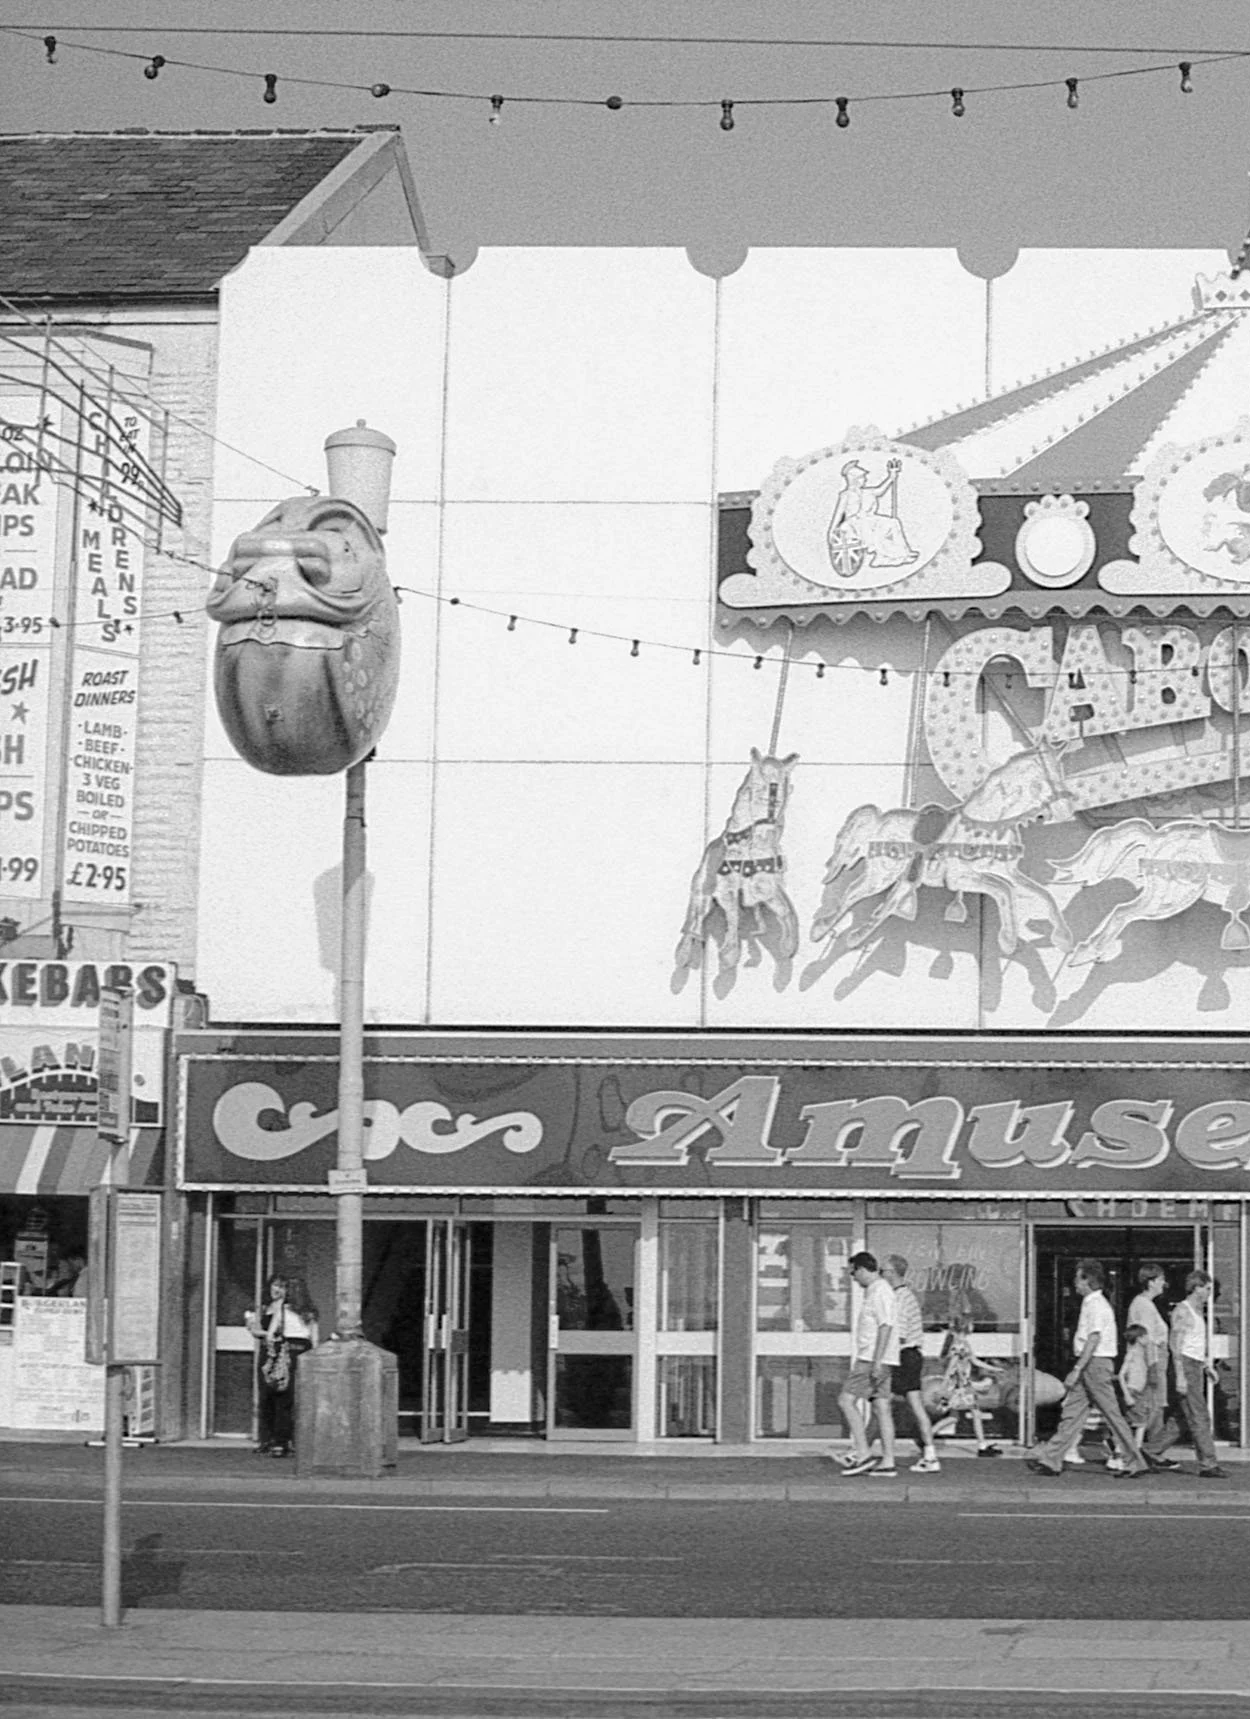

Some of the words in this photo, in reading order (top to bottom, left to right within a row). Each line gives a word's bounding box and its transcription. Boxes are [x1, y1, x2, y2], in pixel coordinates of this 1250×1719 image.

[0, 483, 40, 505] AK
[0, 514, 34, 537] PS
[82, 528, 118, 643] MEALS
[0, 658, 39, 696] SH
[82, 669, 129, 687] ROAST
[73, 689, 136, 707] DINNERS
[84, 720, 122, 739] LAMB
[84, 738, 119, 755] BEEF
[73, 754, 130, 775] CHICKEN
[82, 772, 91, 787] 3
[95, 774, 120, 790] VEG
[75, 789, 125, 809] BOILED
[68, 820, 128, 841] CHIPPED
[66, 837, 130, 859] POTATOES
